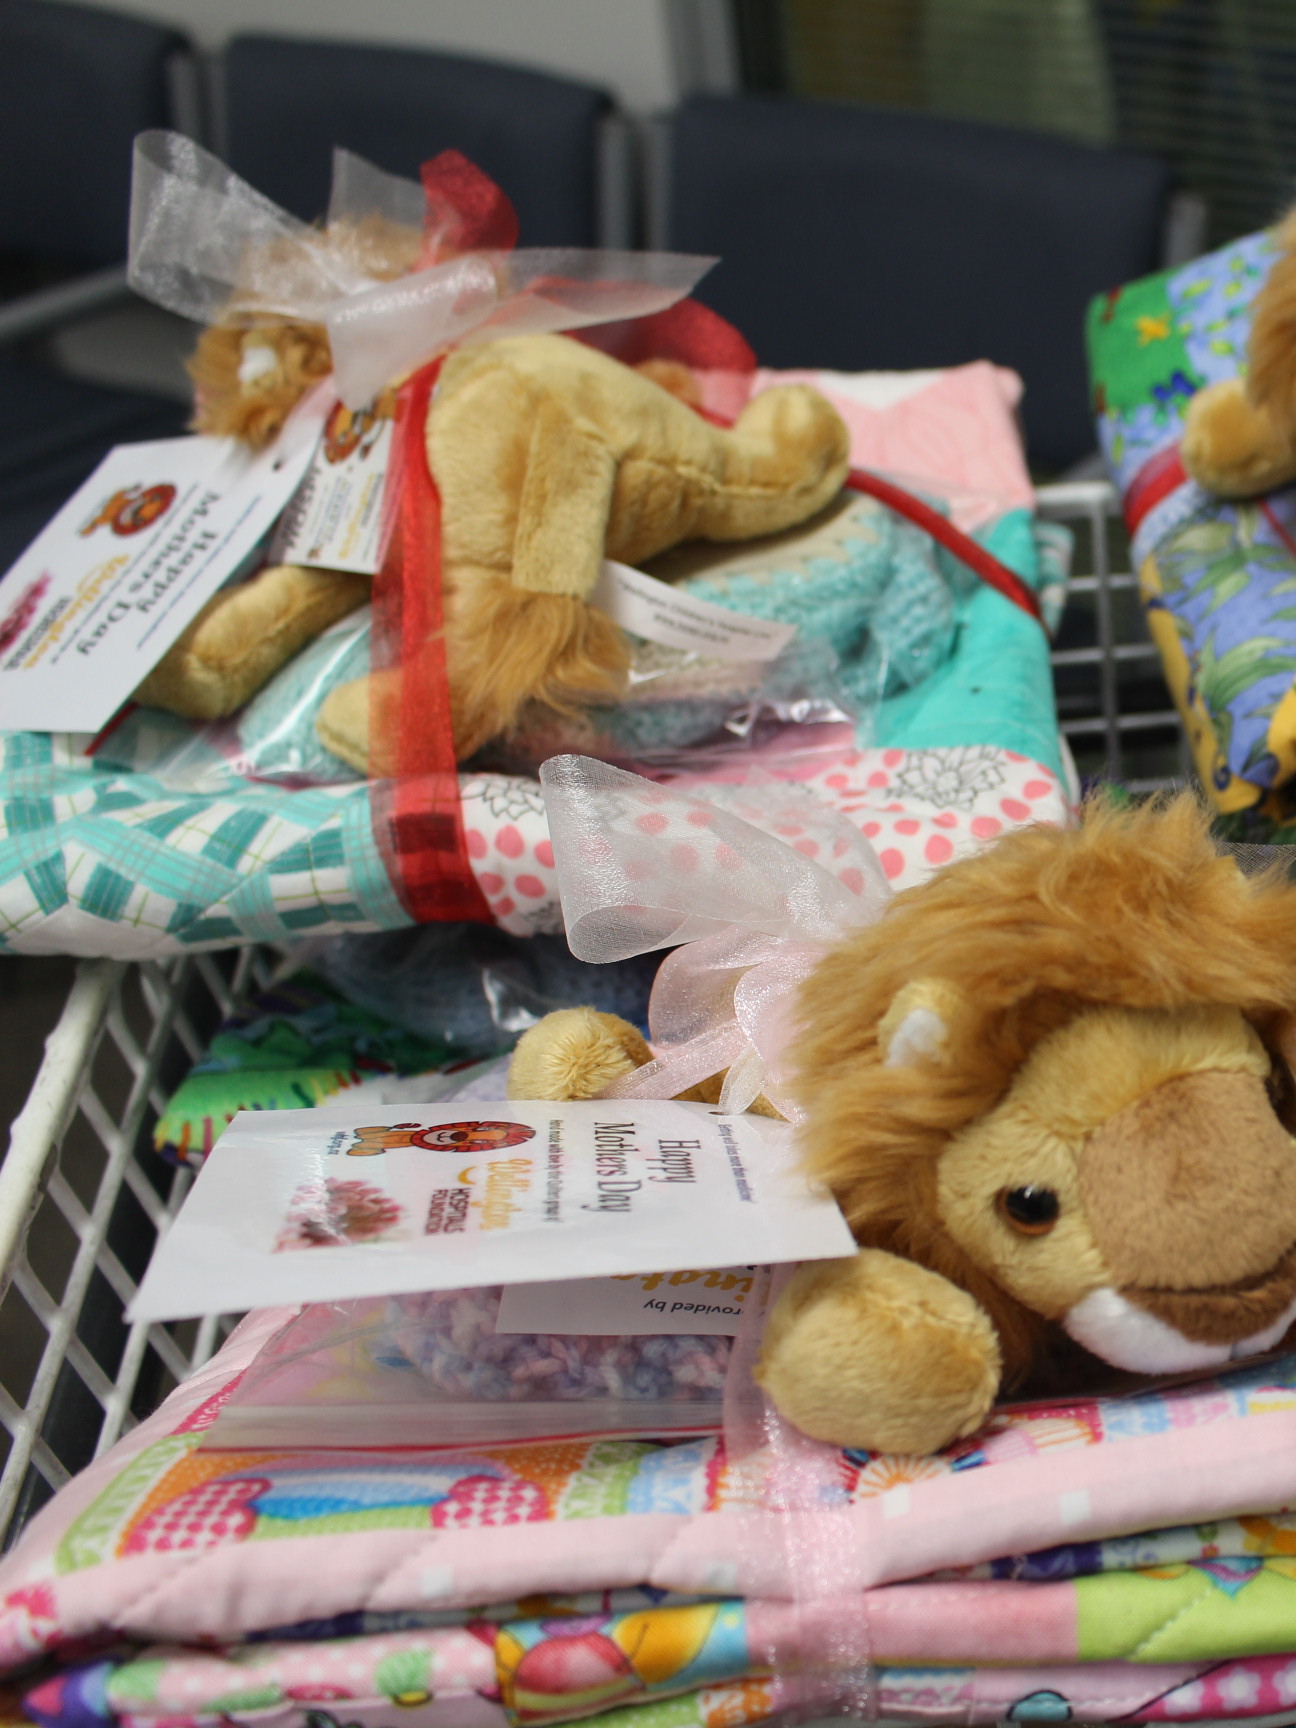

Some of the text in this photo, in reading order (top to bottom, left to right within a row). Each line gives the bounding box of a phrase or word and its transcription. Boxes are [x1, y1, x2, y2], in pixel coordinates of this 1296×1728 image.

[128, 490, 220, 593] Mothers
[136, 530, 218, 613] Happy
[76, 601, 133, 655] Day
[548, 1130, 565, 1143] made
[548, 1143, 565, 1153] with
[549, 1119, 565, 1131] Hand
[547, 1153, 564, 1164] love
[580, 1121, 643, 1213] Mothers Day
[645, 1139, 702, 1184] Happy
[425, 1189, 448, 1236] FOUNDATION
[443, 1187, 472, 1234] HOSPITALS
[470, 1158, 534, 1231] Wellington
[643, 1299, 744, 1316] rovided by
